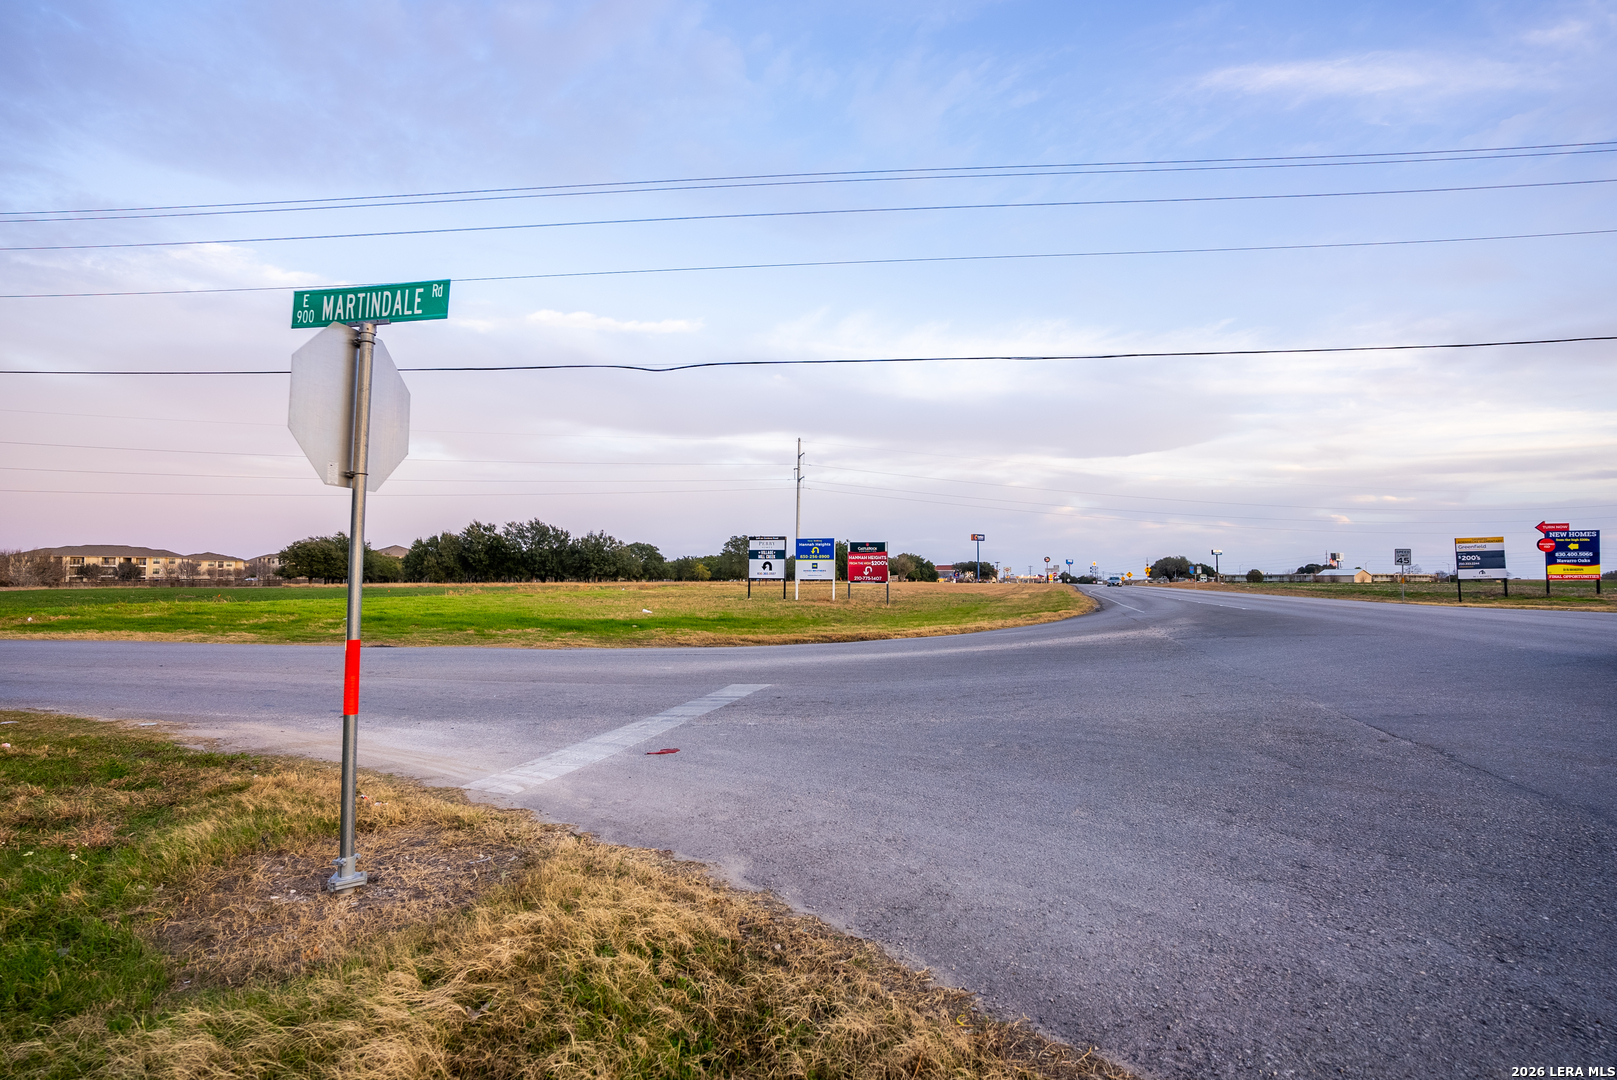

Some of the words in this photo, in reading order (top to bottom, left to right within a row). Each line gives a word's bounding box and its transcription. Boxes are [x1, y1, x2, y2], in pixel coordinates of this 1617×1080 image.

[303, 294, 310, 308] E
[322, 288, 424, 321] MARTINDALE
[432, 283, 443, 298] Rd
[296, 309, 315, 323] 900
